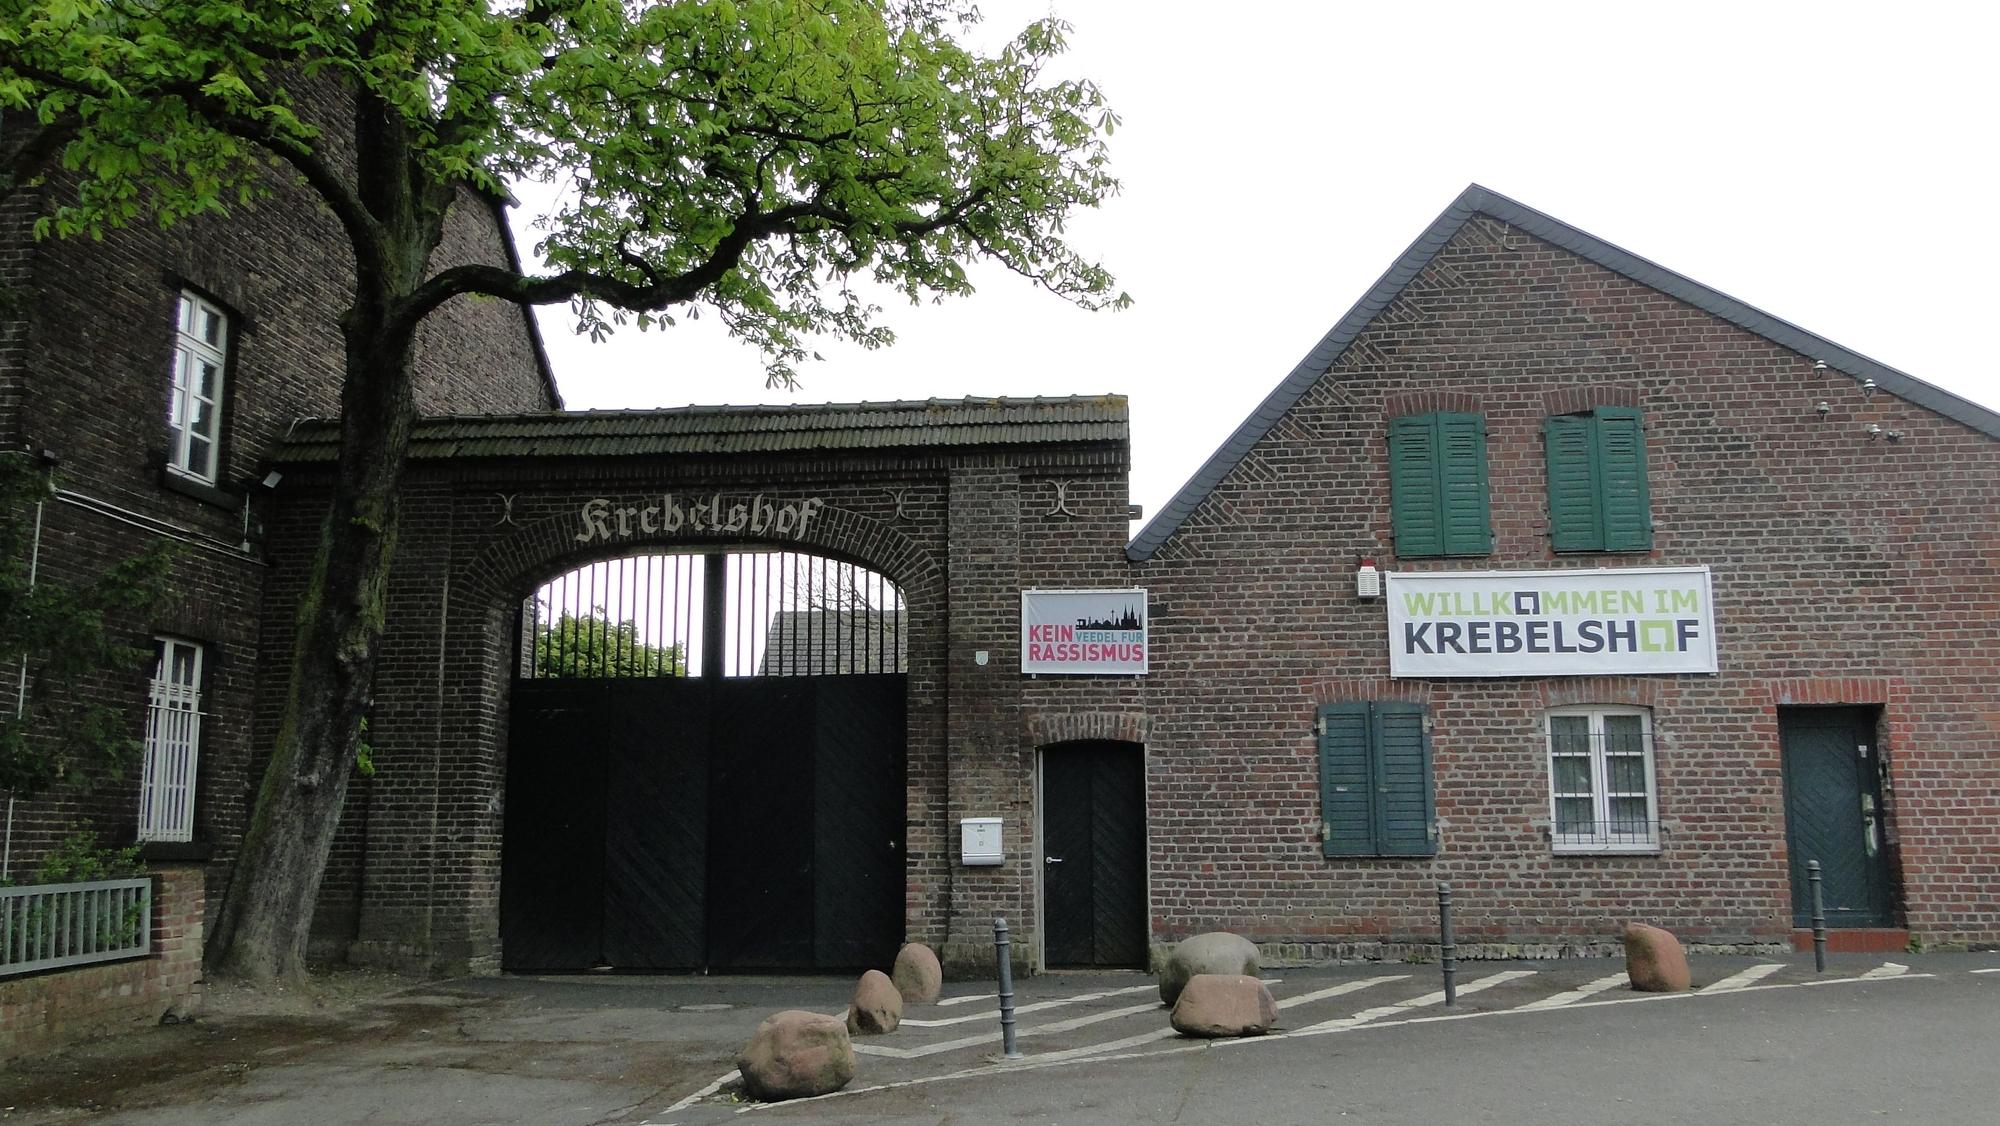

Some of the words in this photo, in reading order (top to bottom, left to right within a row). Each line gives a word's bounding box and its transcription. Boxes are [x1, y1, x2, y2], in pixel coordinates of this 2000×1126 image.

[576, 493, 824, 542] Krebelshof
[1403, 589, 1644, 616] WILLKOMMEN
[1654, 589, 1698, 614] IM
[1029, 625, 1073, 642] KEIN
[1075, 632, 1117, 642] VEEDEL
[1404, 619, 1699, 654] KREBELSHOF
[1029, 644, 1144, 662] RASSISMUS
